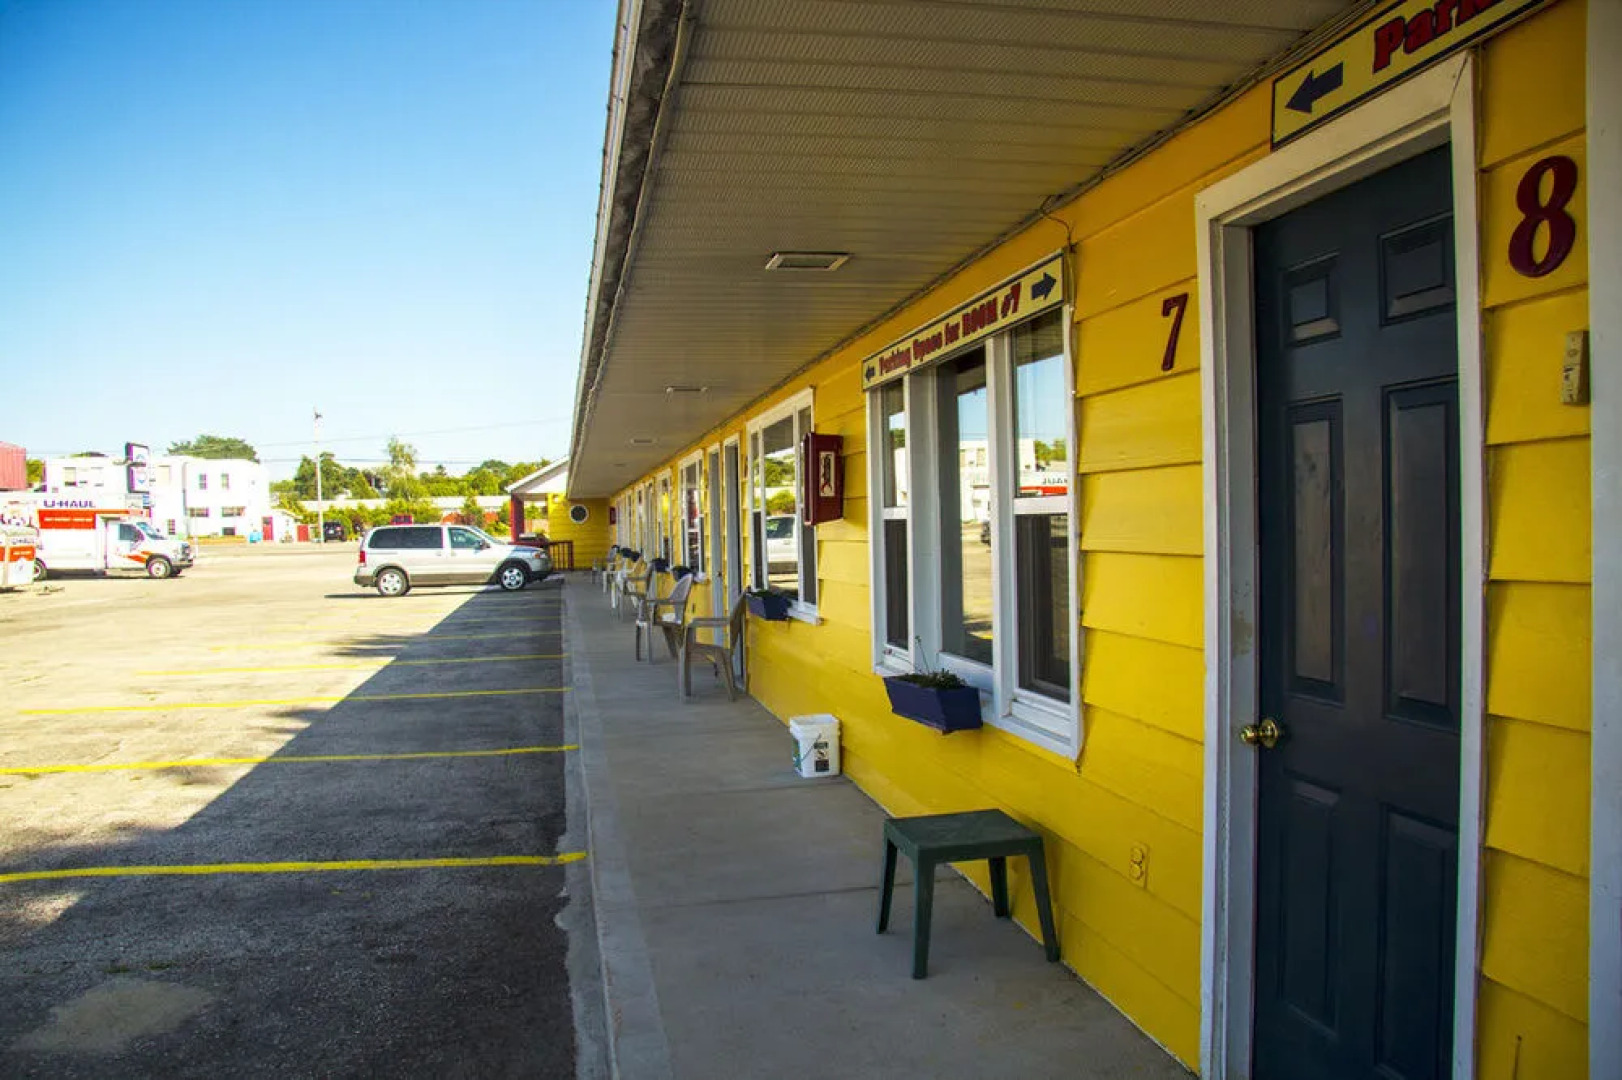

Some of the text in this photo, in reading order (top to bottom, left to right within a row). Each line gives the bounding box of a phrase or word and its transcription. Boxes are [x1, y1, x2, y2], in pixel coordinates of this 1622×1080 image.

[1508, 154, 1579, 279] 8
[878, 346, 911, 376] Parking
[945, 322, 960, 346] for
[962, 296, 998, 338] ROOM
[1161, 292, 1189, 372] 7
[43, 500, 96, 509] U-HAUL
